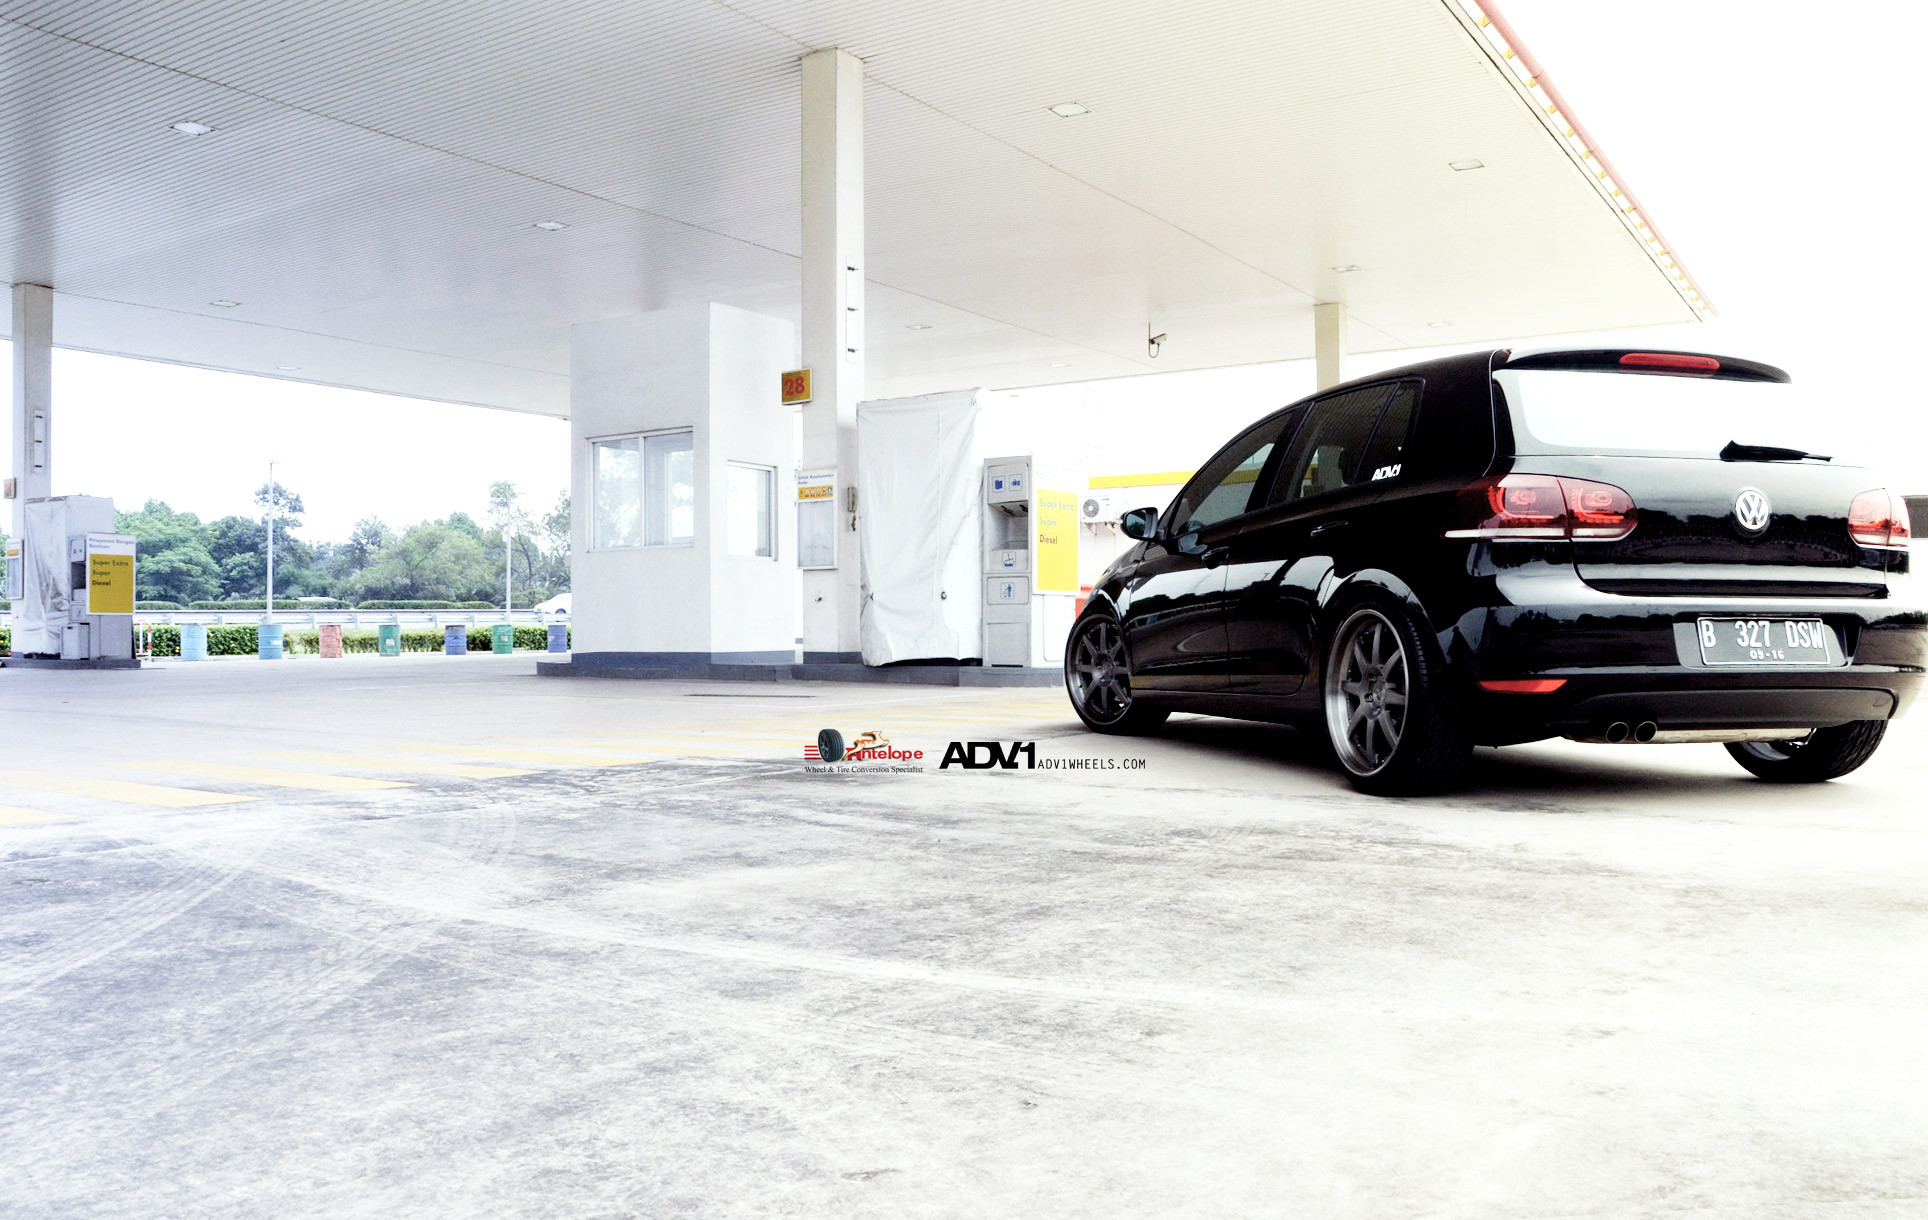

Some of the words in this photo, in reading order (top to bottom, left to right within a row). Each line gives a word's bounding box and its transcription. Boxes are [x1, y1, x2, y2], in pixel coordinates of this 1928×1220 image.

[784, 376, 805, 396] 28
[1039, 516, 1058, 527] Super
[1039, 534, 1058, 545] Diesel
[1701, 620, 1717, 648] B
[1734, 620, 1771, 648] 327
[1785, 620, 1824, 649] DSW
